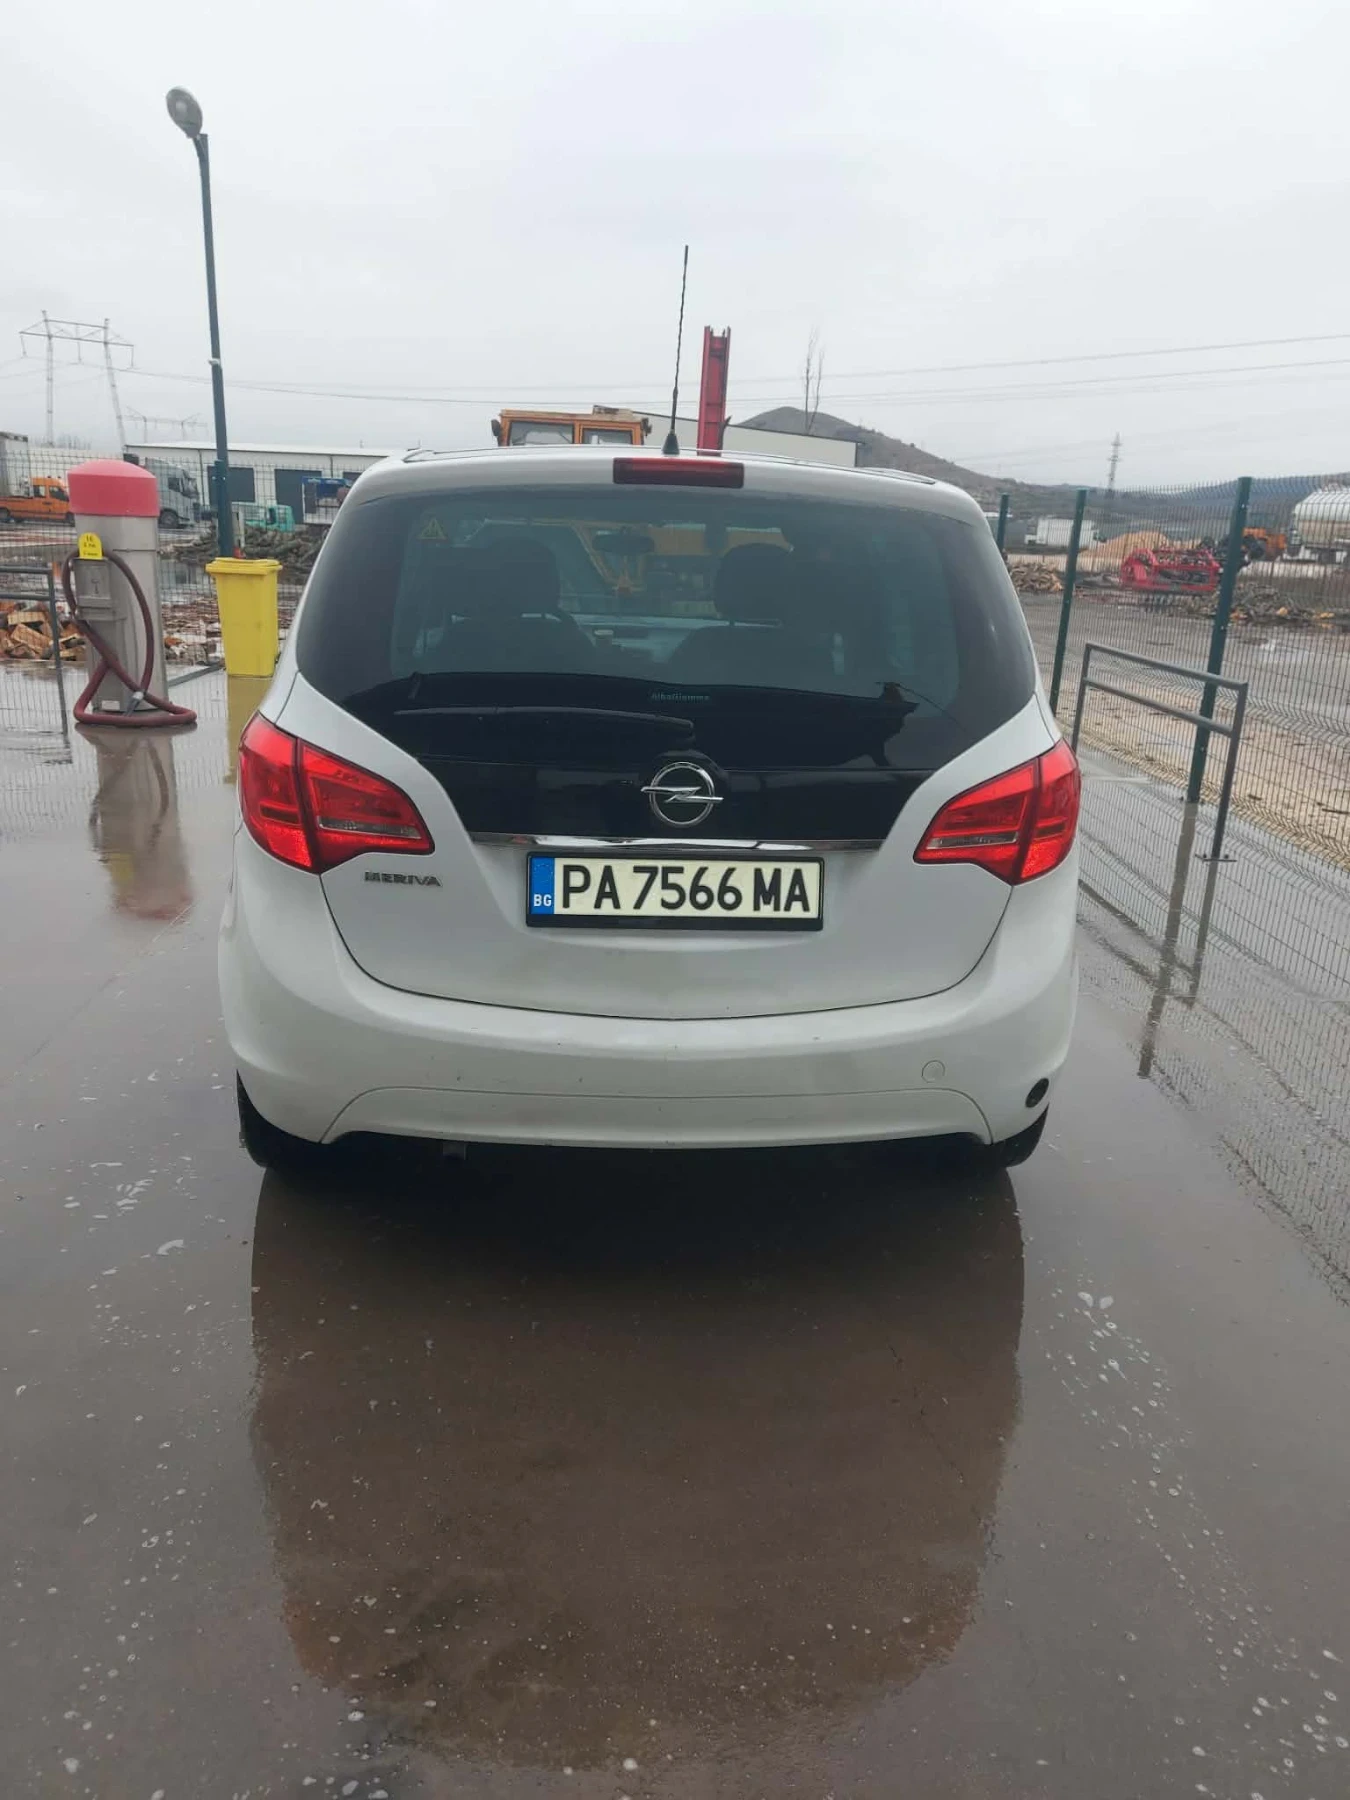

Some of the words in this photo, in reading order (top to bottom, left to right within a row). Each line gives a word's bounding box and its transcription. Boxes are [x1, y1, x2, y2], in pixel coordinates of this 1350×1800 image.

[364, 871, 443, 887] MERIVA
[562, 864, 622, 910] PA
[632, 865, 743, 912] 7566
[753, 867, 811, 912] MA
[533, 893, 553, 907] BG
